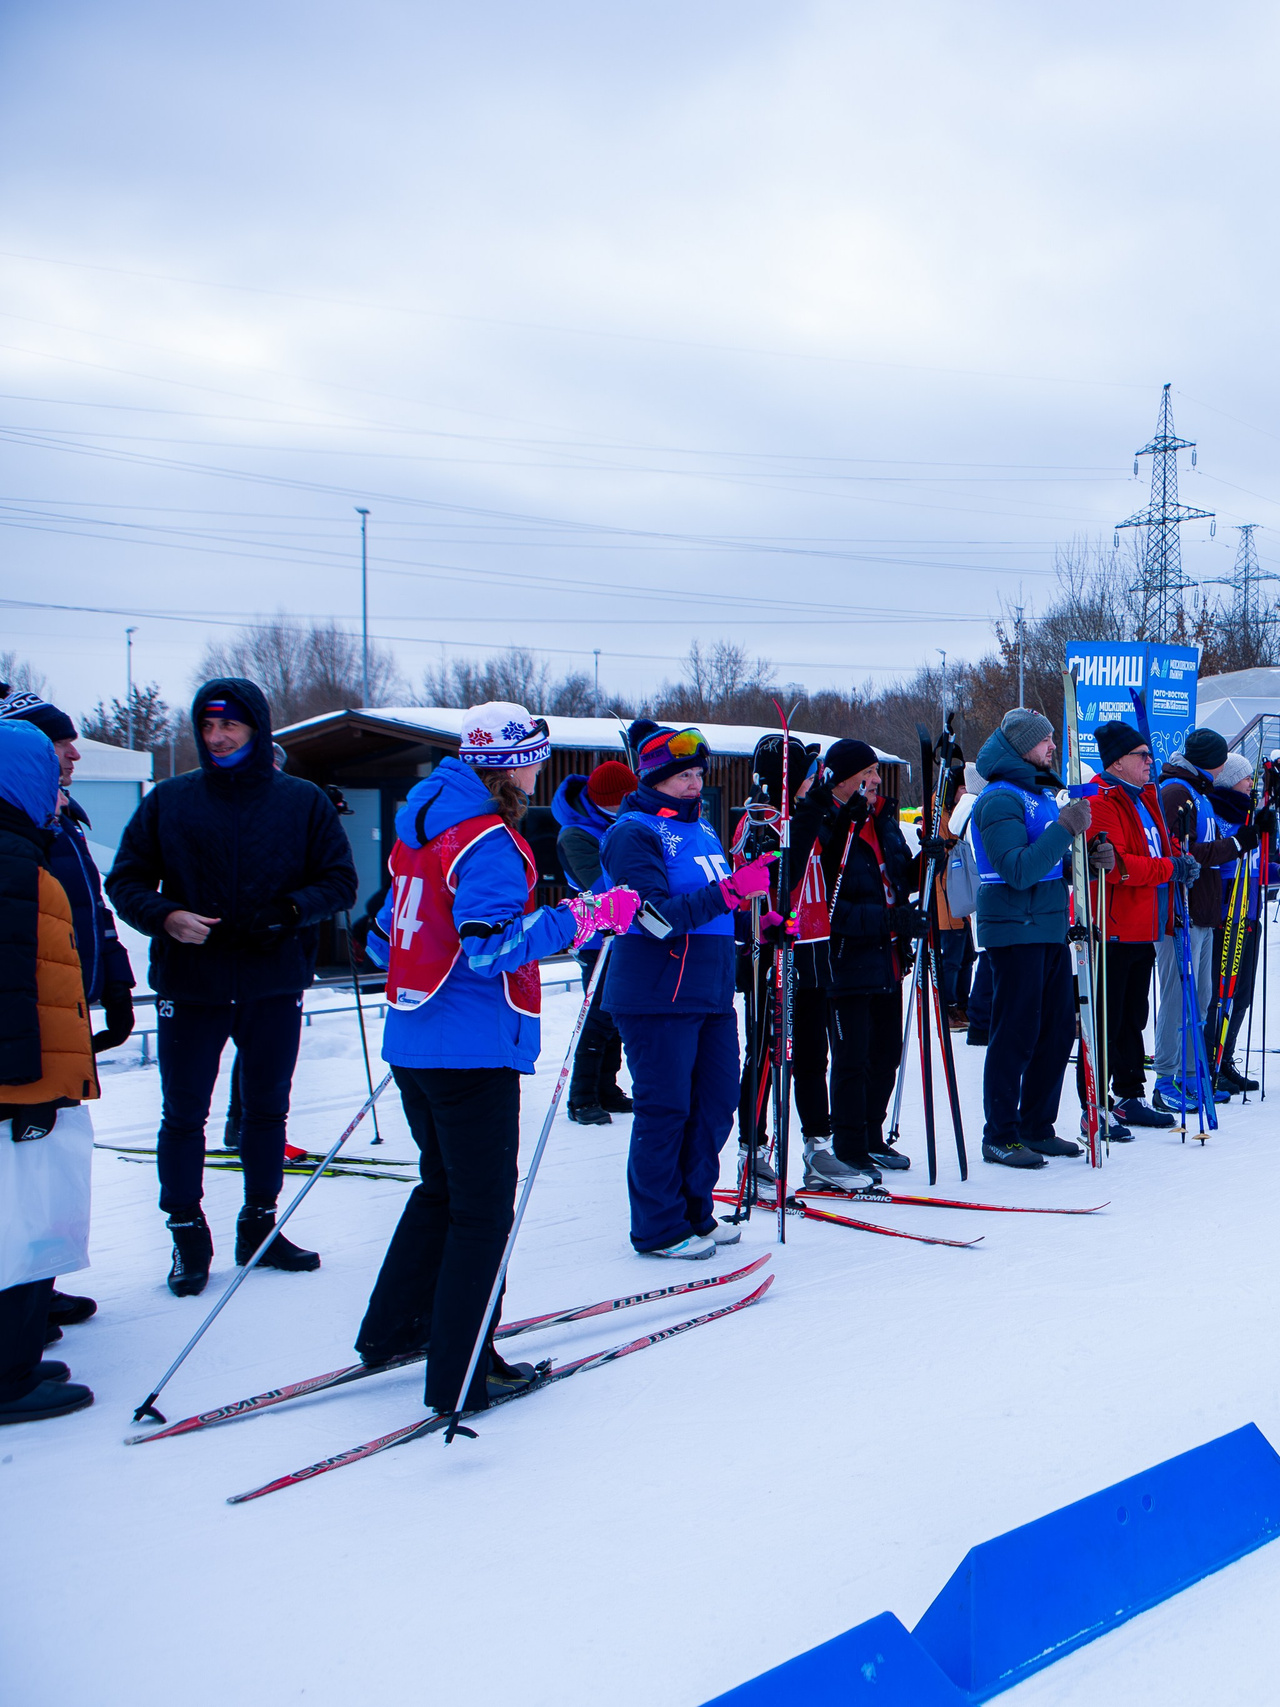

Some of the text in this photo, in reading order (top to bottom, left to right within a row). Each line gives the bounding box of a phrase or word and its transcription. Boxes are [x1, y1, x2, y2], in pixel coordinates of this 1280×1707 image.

[1069, 655, 1143, 687] ФИНИШ
[1098, 701, 1135, 712] МОСКОВСК
[1153, 689, 1189, 699] ЮГО-ВОСТОК
[1098, 712, 1121, 721] ЛЫЖНЯ
[828, 873, 842, 923] ALOMON
[1221, 915, 1233, 976] SALOMON
[1232, 915, 1246, 974] SALOMON
[159, 1000, 174, 1017] 25
[851, 1193, 892, 1203] ATOMIC
[197, 1389, 283, 1424] OMNI
[291, 1445, 370, 1480] OMNI
